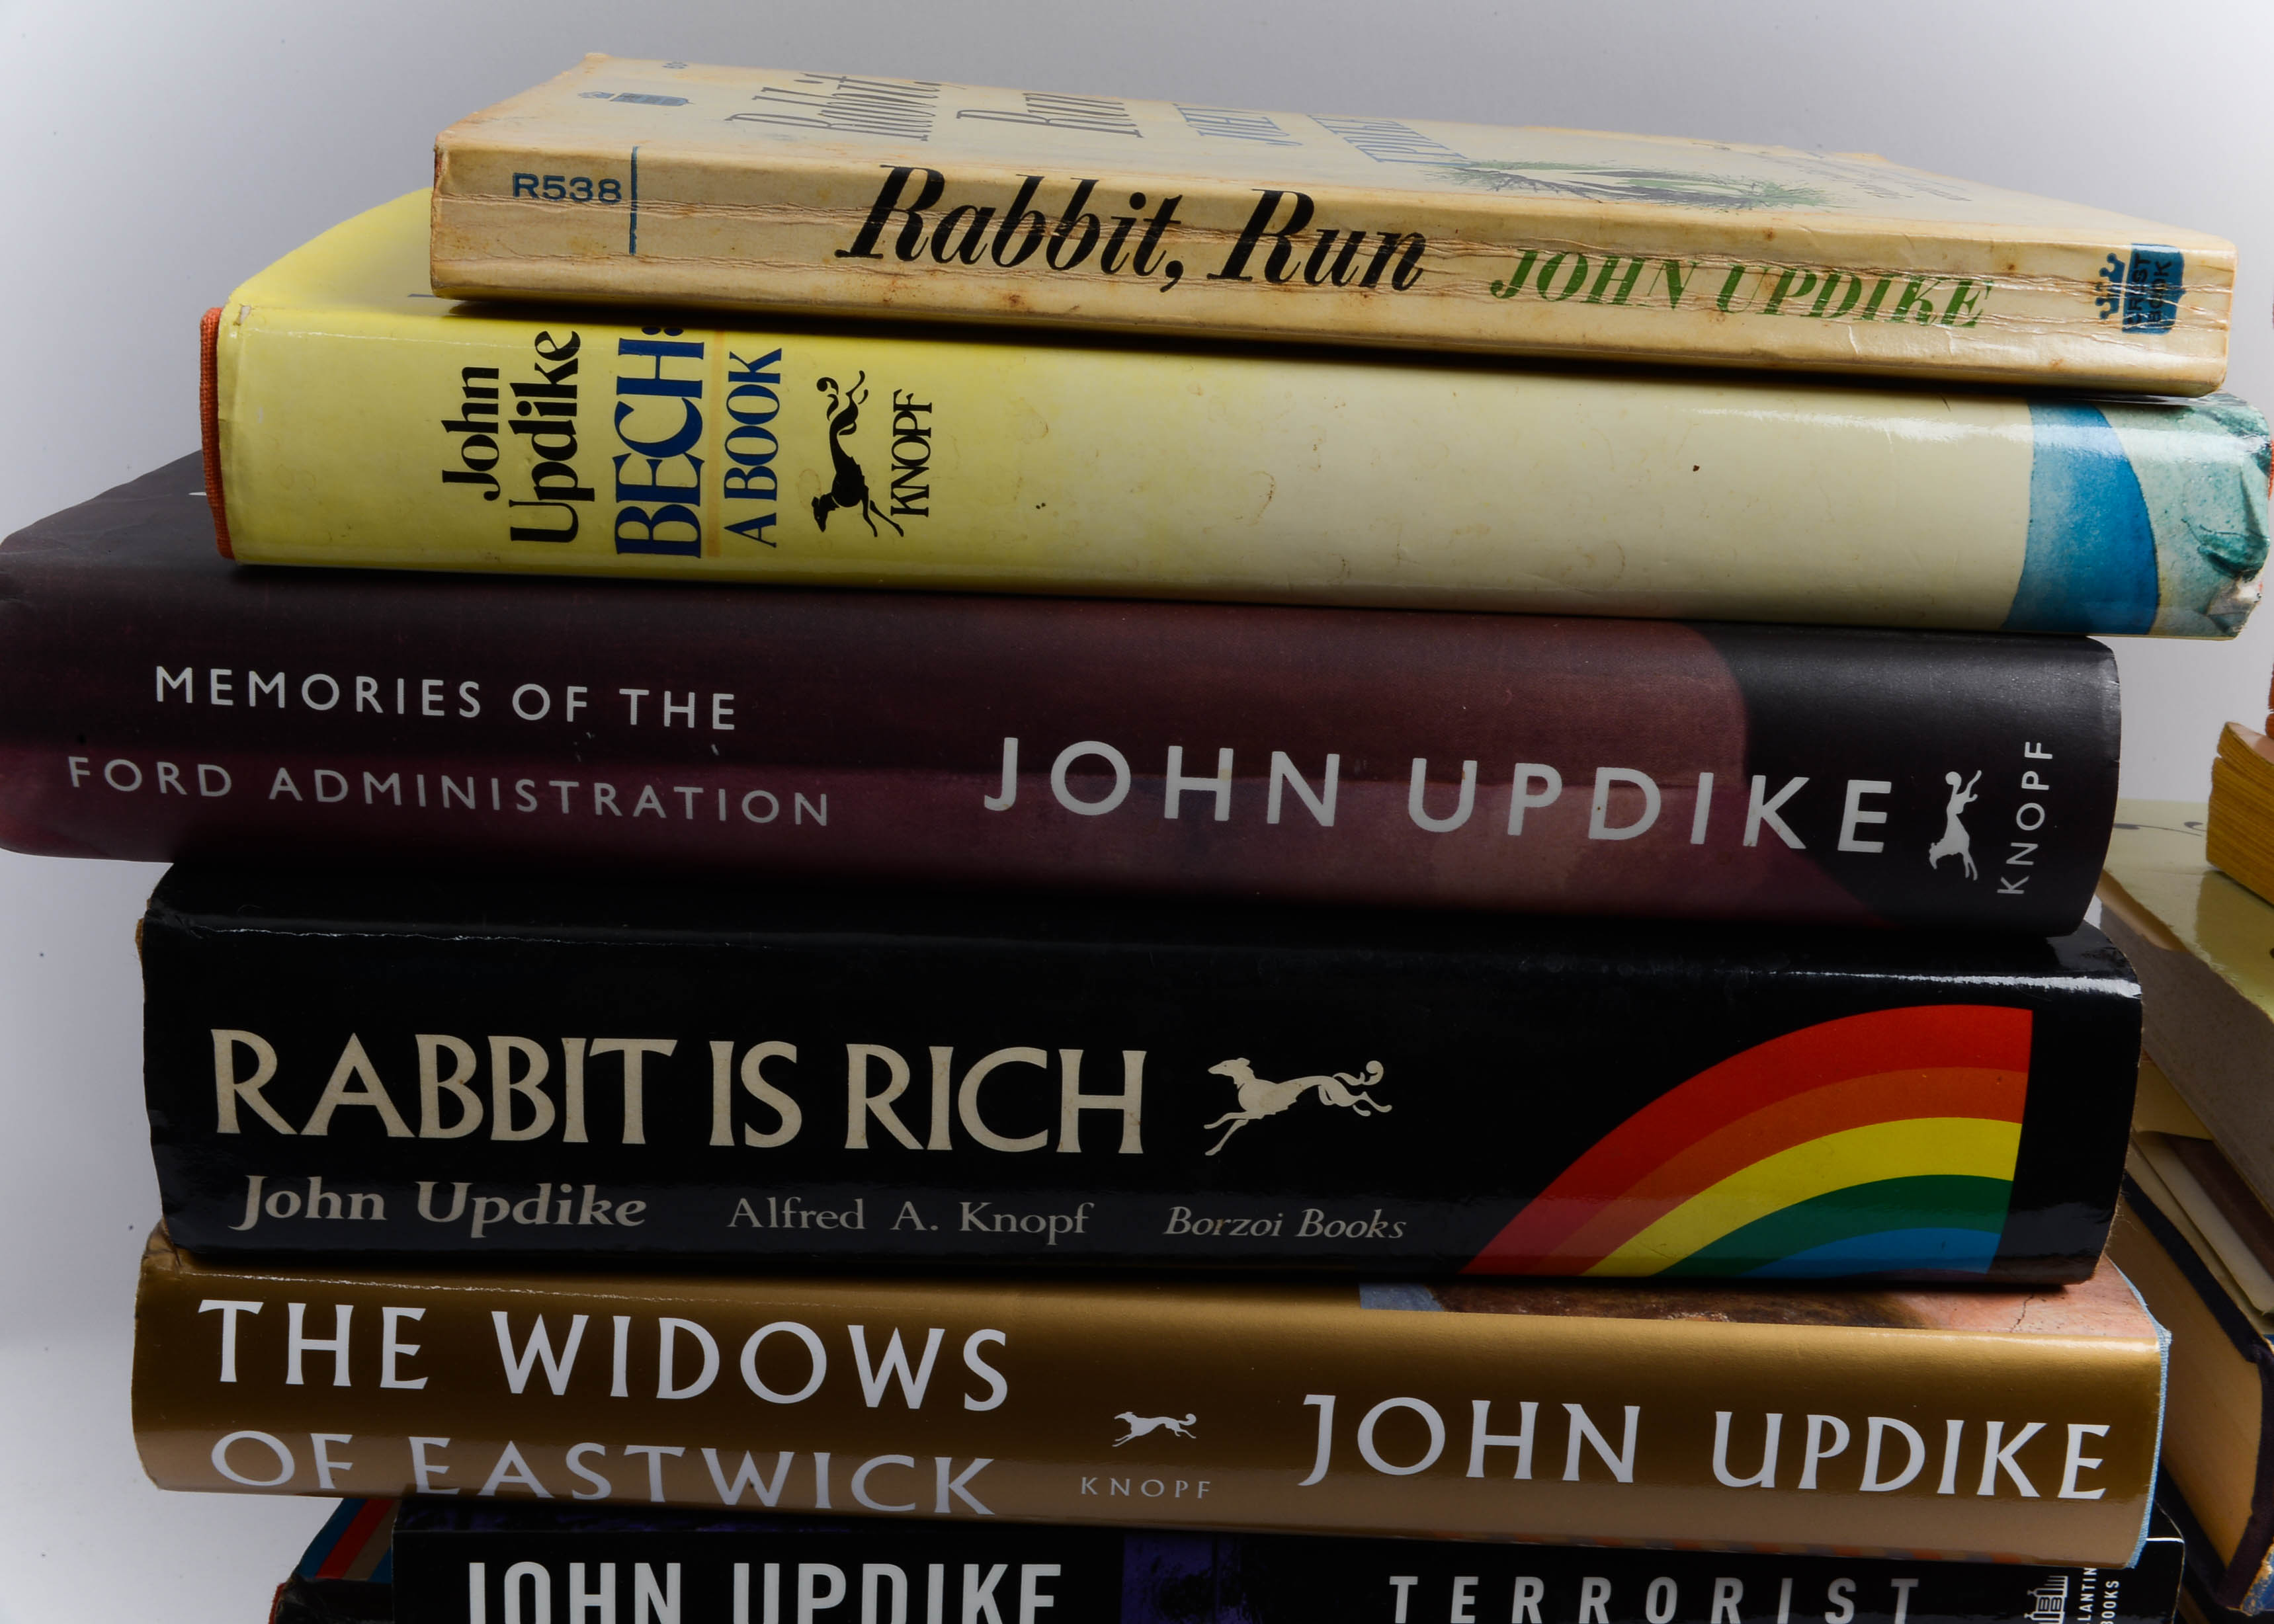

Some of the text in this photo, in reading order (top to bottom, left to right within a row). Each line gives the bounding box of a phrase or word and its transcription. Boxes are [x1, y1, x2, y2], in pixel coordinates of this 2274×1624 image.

[955, 93, 1144, 138] Run
[513, 173, 622, 204] R538
[834, 164, 1427, 293] Rabbit, Run
[1490, 248, 1995, 329] JOHN UPDIKE
[441, 367, 501, 501] John
[508, 331, 595, 544] Updike
[616, 326, 705, 557] BECH:
[724, 348, 781, 548] A BOOK
[890, 389, 932, 517] KNOPF
[157, 666, 734, 729] MEMORIES OF THE
[69, 756, 827, 826] FORD ADMINISTRATION
[984, 737, 1891, 852] JOHN UPDIKE
[1998, 742, 2052, 894] KNOPF
[211, 1030, 1147, 1153] RABBIT IS RICH
[229, 1176, 646, 1238] John Updike
[728, 1197, 1094, 1245] Alfred A. Knopf
[1164, 1207, 1406, 1238] Borzoi Books
[198, 1299, 1009, 1410] THE WIDOWS
[211, 1431, 995, 1514] OF EASTWICK
[1081, 1477, 1210, 1498] KNOPF
[1298, 1395, 2110, 1499] JOHN UPDIKE
[470, 1562, 1061, 1624] JOHN UPDIKE
[1390, 1576, 1917, 1624] TERRORIST
